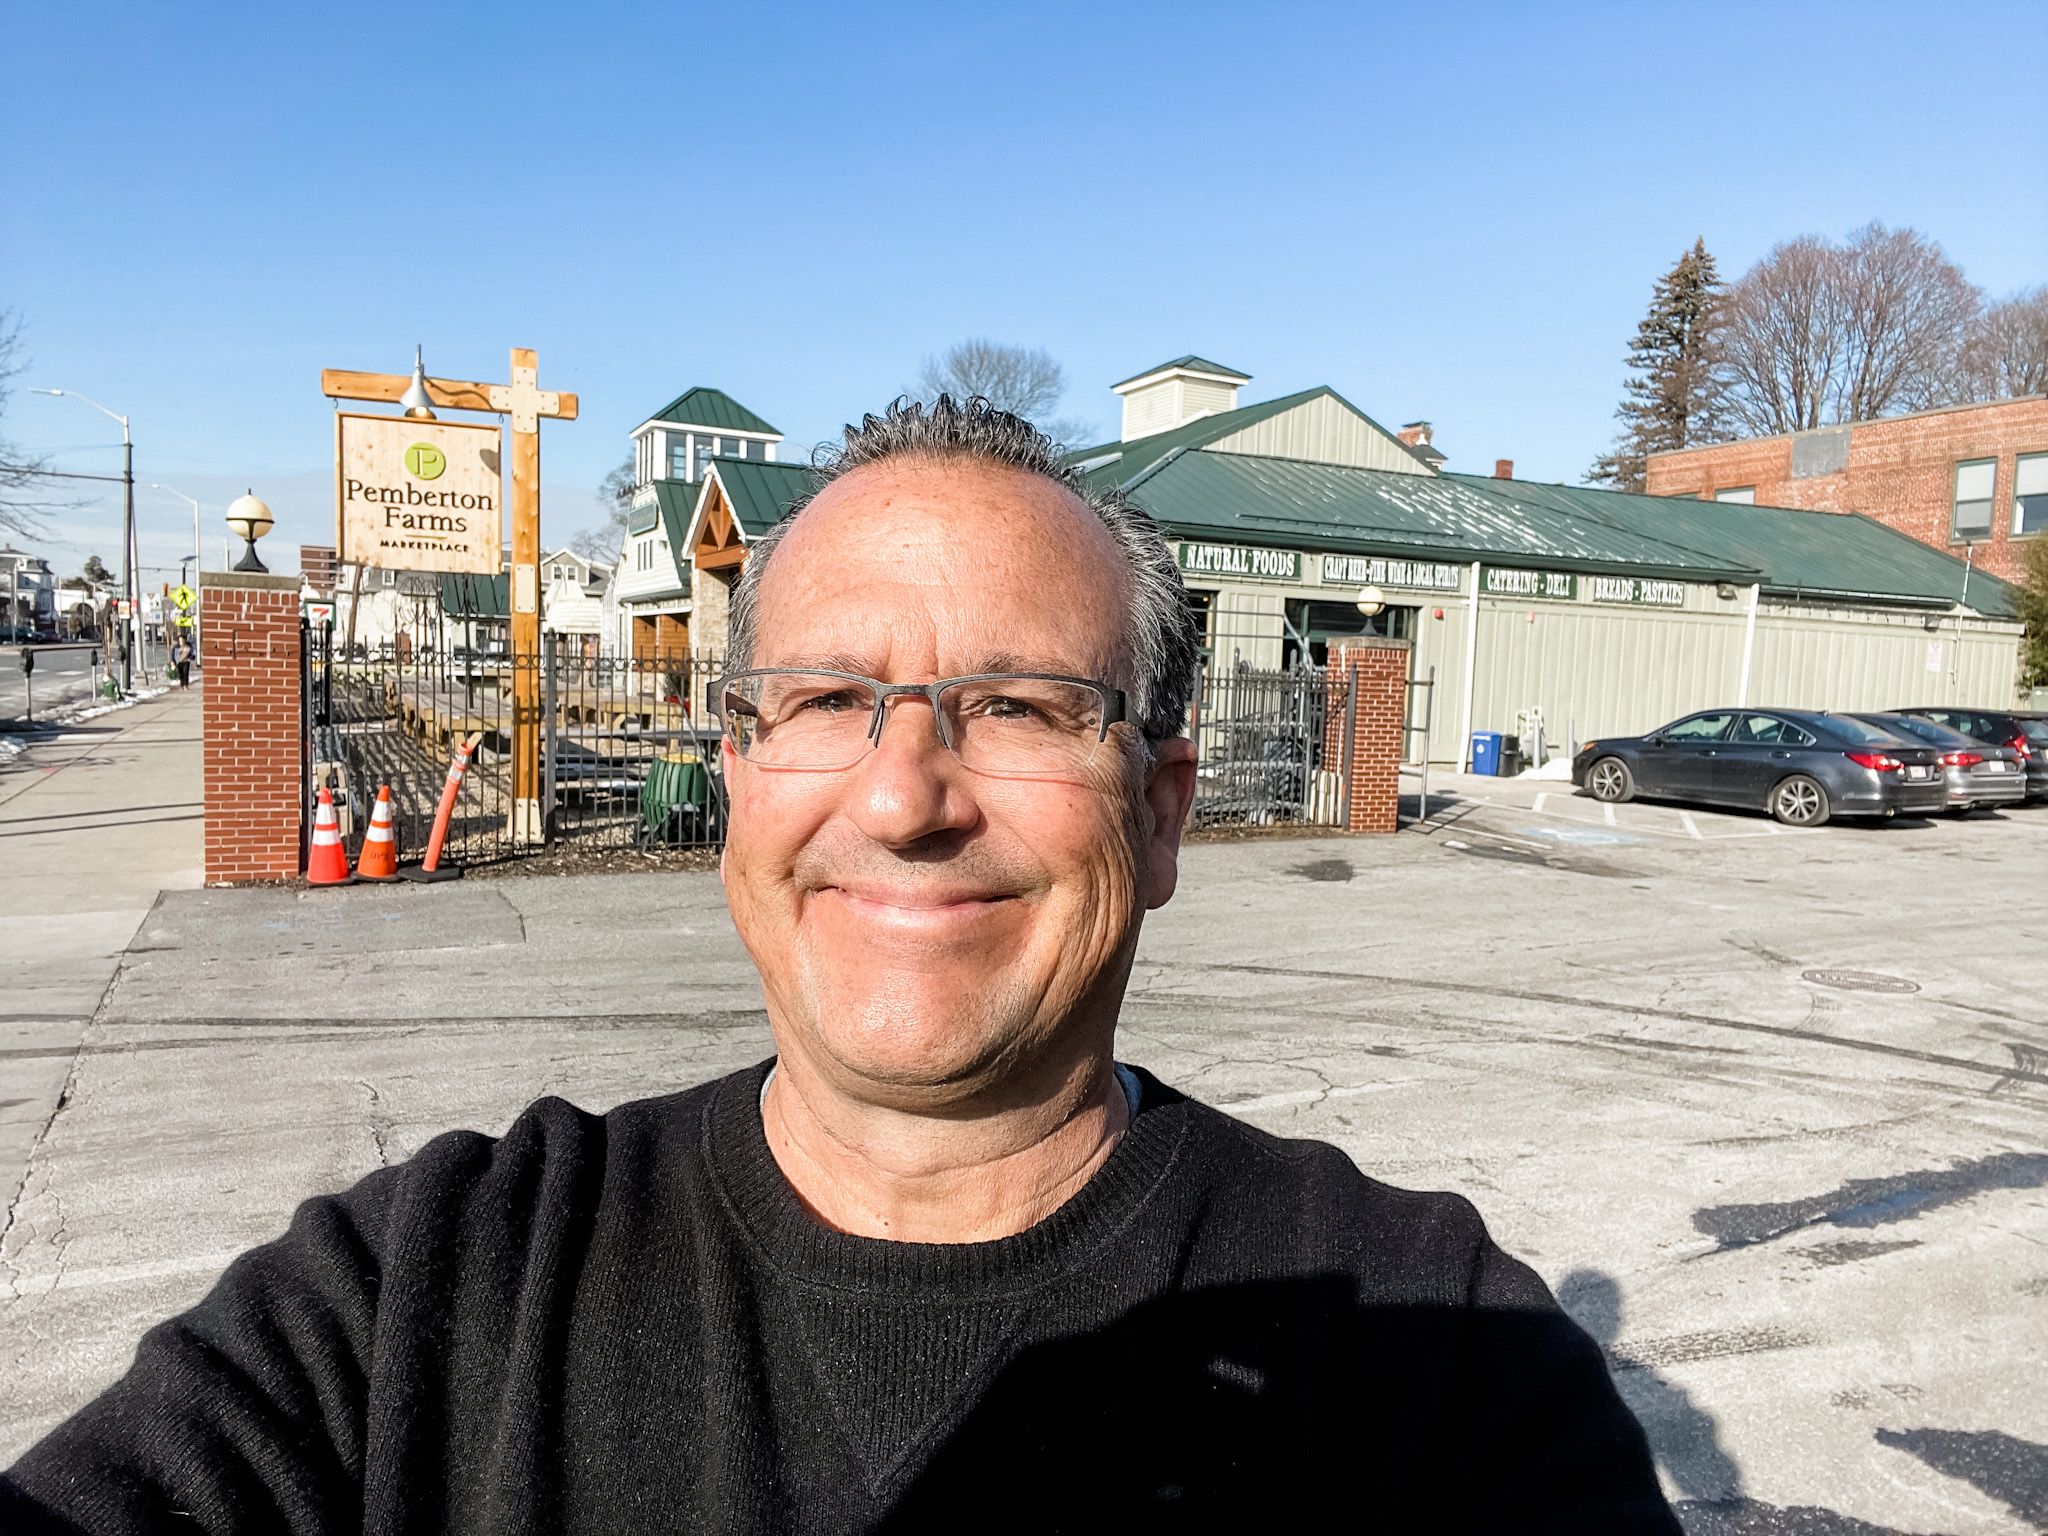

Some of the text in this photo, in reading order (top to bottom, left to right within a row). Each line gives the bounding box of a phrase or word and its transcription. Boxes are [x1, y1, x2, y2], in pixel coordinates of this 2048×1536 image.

[412, 446, 437, 475] P
[346, 479, 493, 511] Pemberton
[384, 506, 467, 532] Farms
[380, 540, 469, 552] MARKETPLACE
[1186, 544, 1295, 577] NATURAL FOODS
[1324, 556, 1347, 580] CRAFT
[1412, 563, 1434, 586] LOCAL
[1487, 569, 1571, 596] CATERING DELI
[1595, 577, 1684, 604] BREADS PASTRIES
